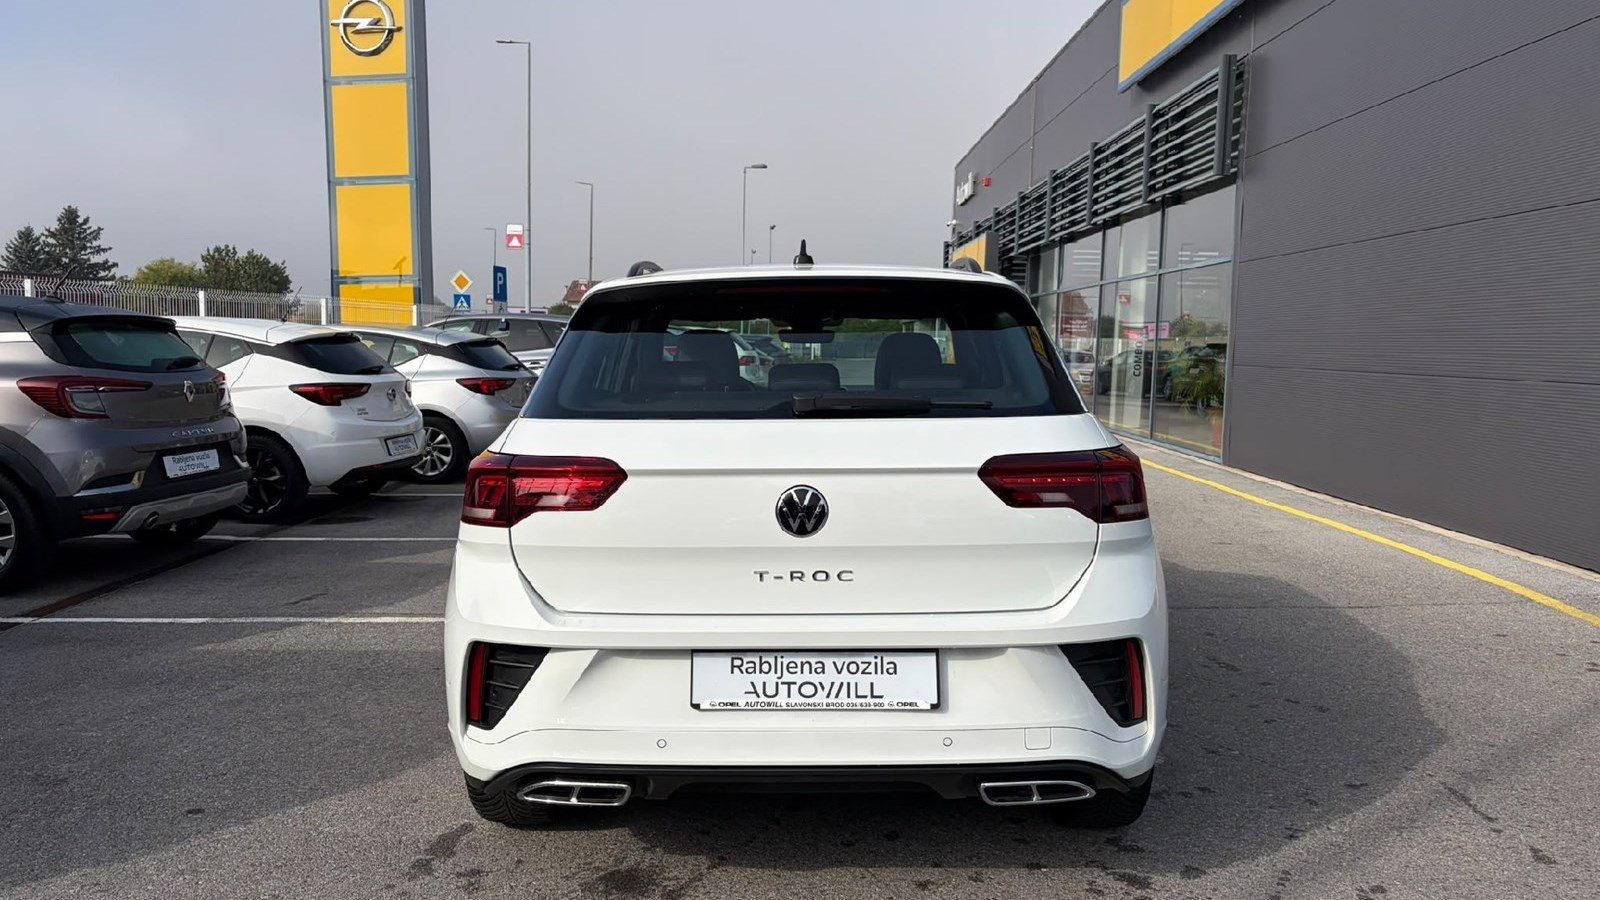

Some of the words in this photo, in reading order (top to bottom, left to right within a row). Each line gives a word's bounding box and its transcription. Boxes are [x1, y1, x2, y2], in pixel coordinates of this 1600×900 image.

[497, 272, 504, 294] P
[753, 570, 854, 582] T-ROC
[730, 655, 826, 680] Rabljena
[832, 655, 898, 675] vozila
[744, 681, 885, 699] AUTOWILL
